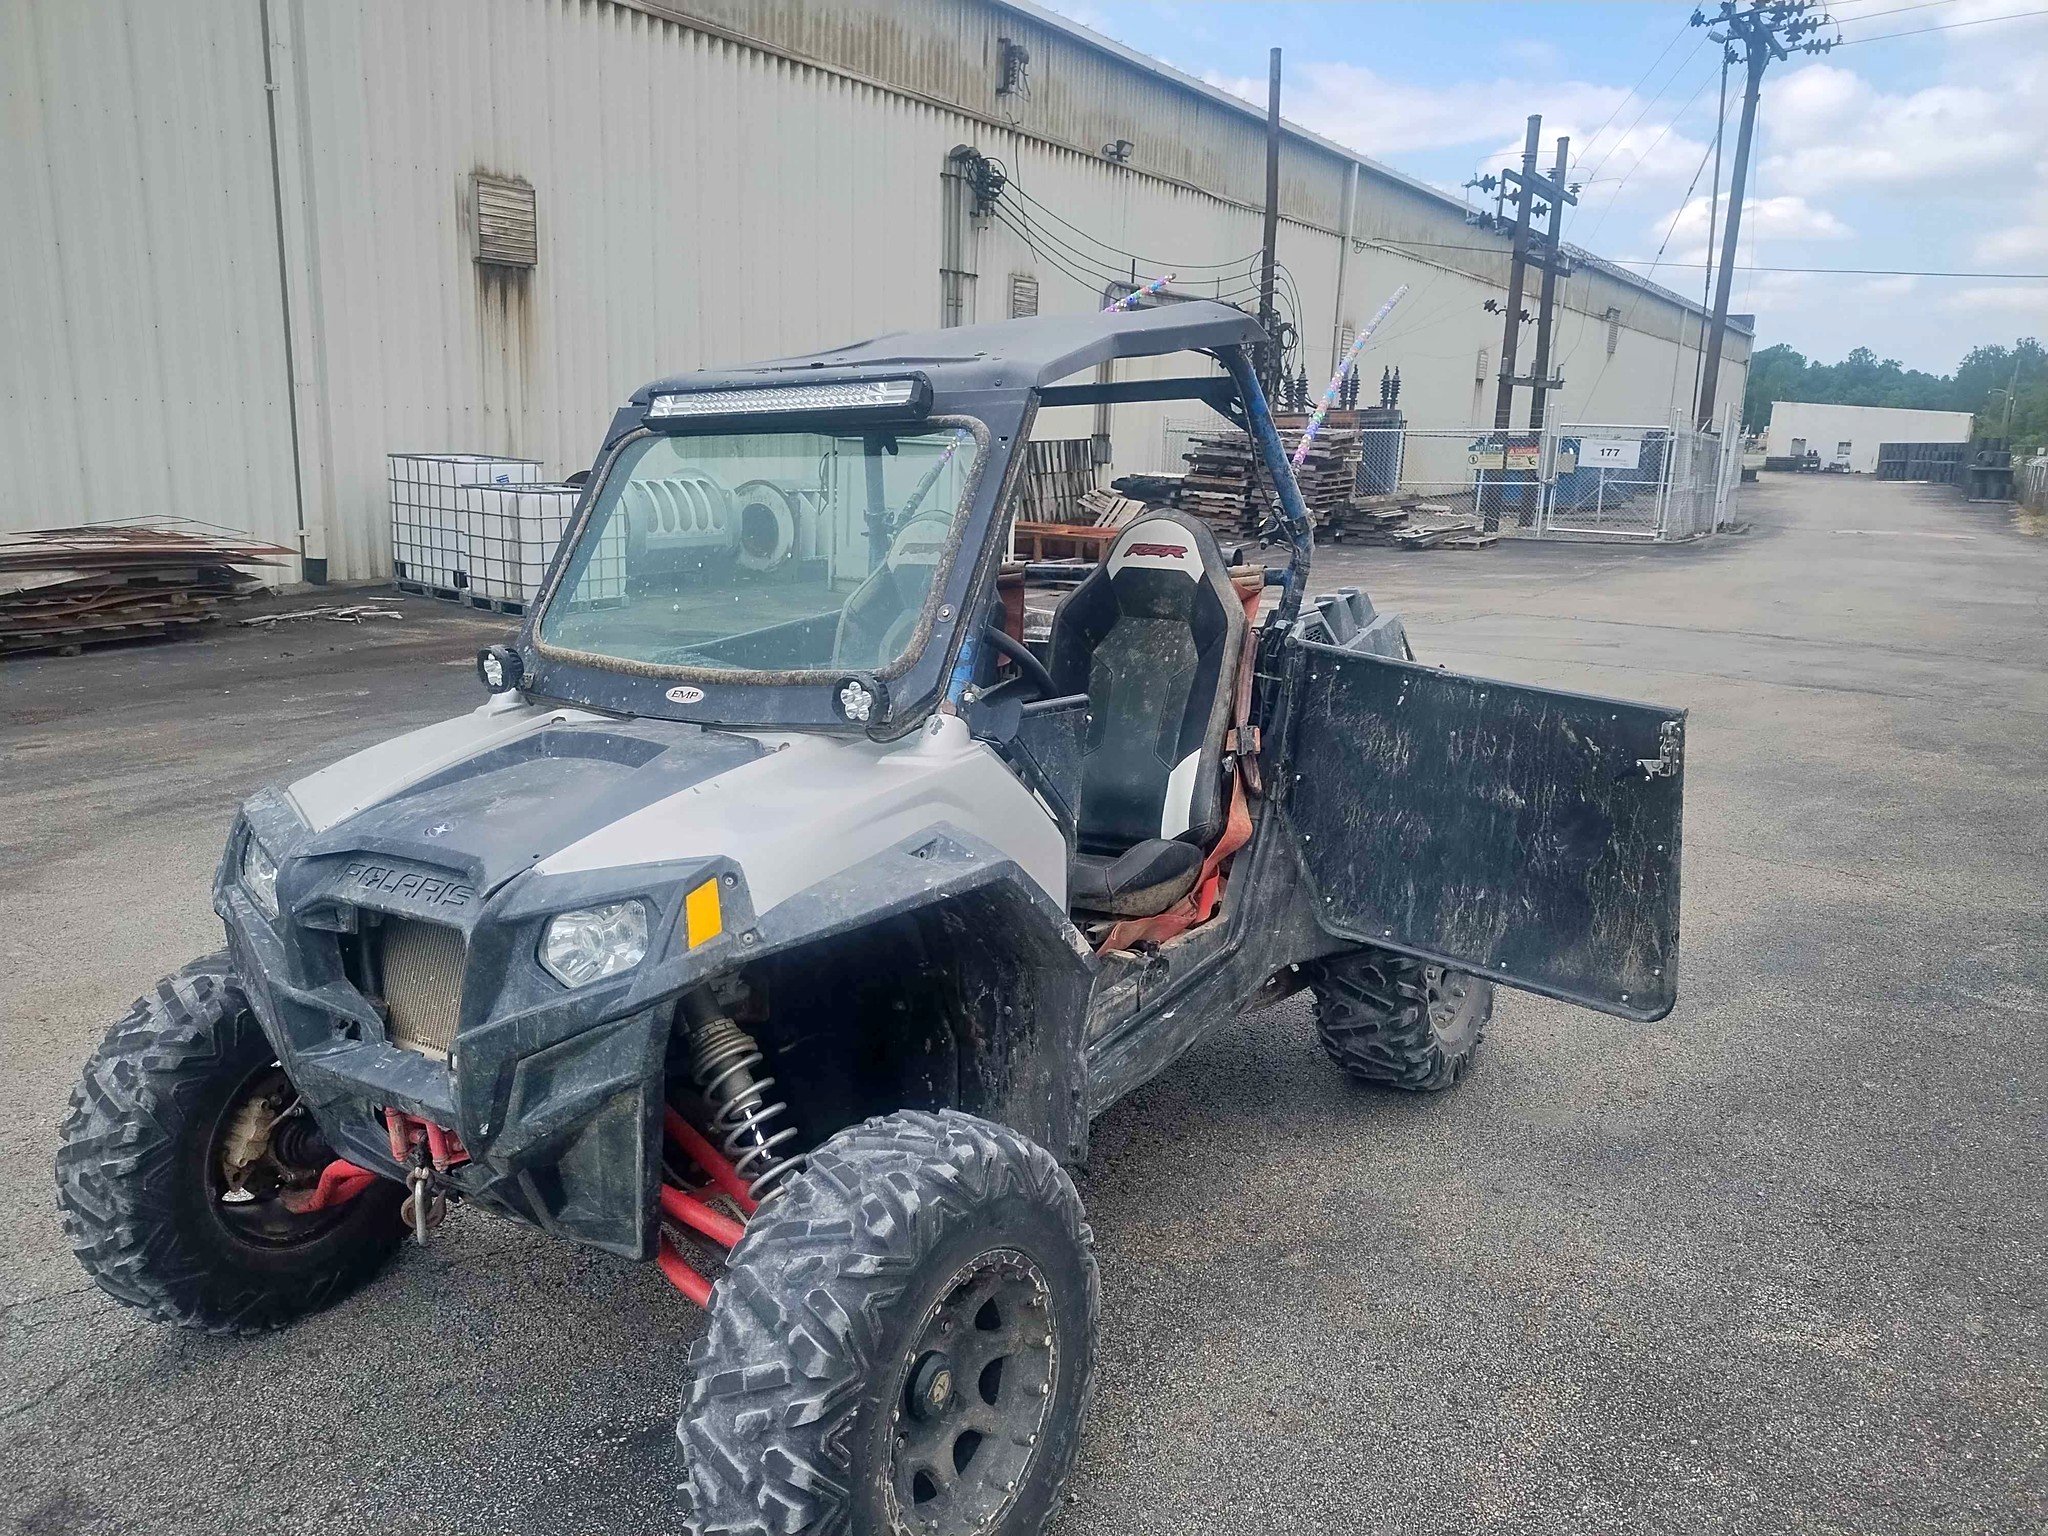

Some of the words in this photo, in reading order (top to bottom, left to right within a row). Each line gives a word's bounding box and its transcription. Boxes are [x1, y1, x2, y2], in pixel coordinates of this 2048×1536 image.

[1600, 448, 1620, 457] 177
[671, 689, 699, 699] EMP
[337, 862, 476, 906] POLARIS
